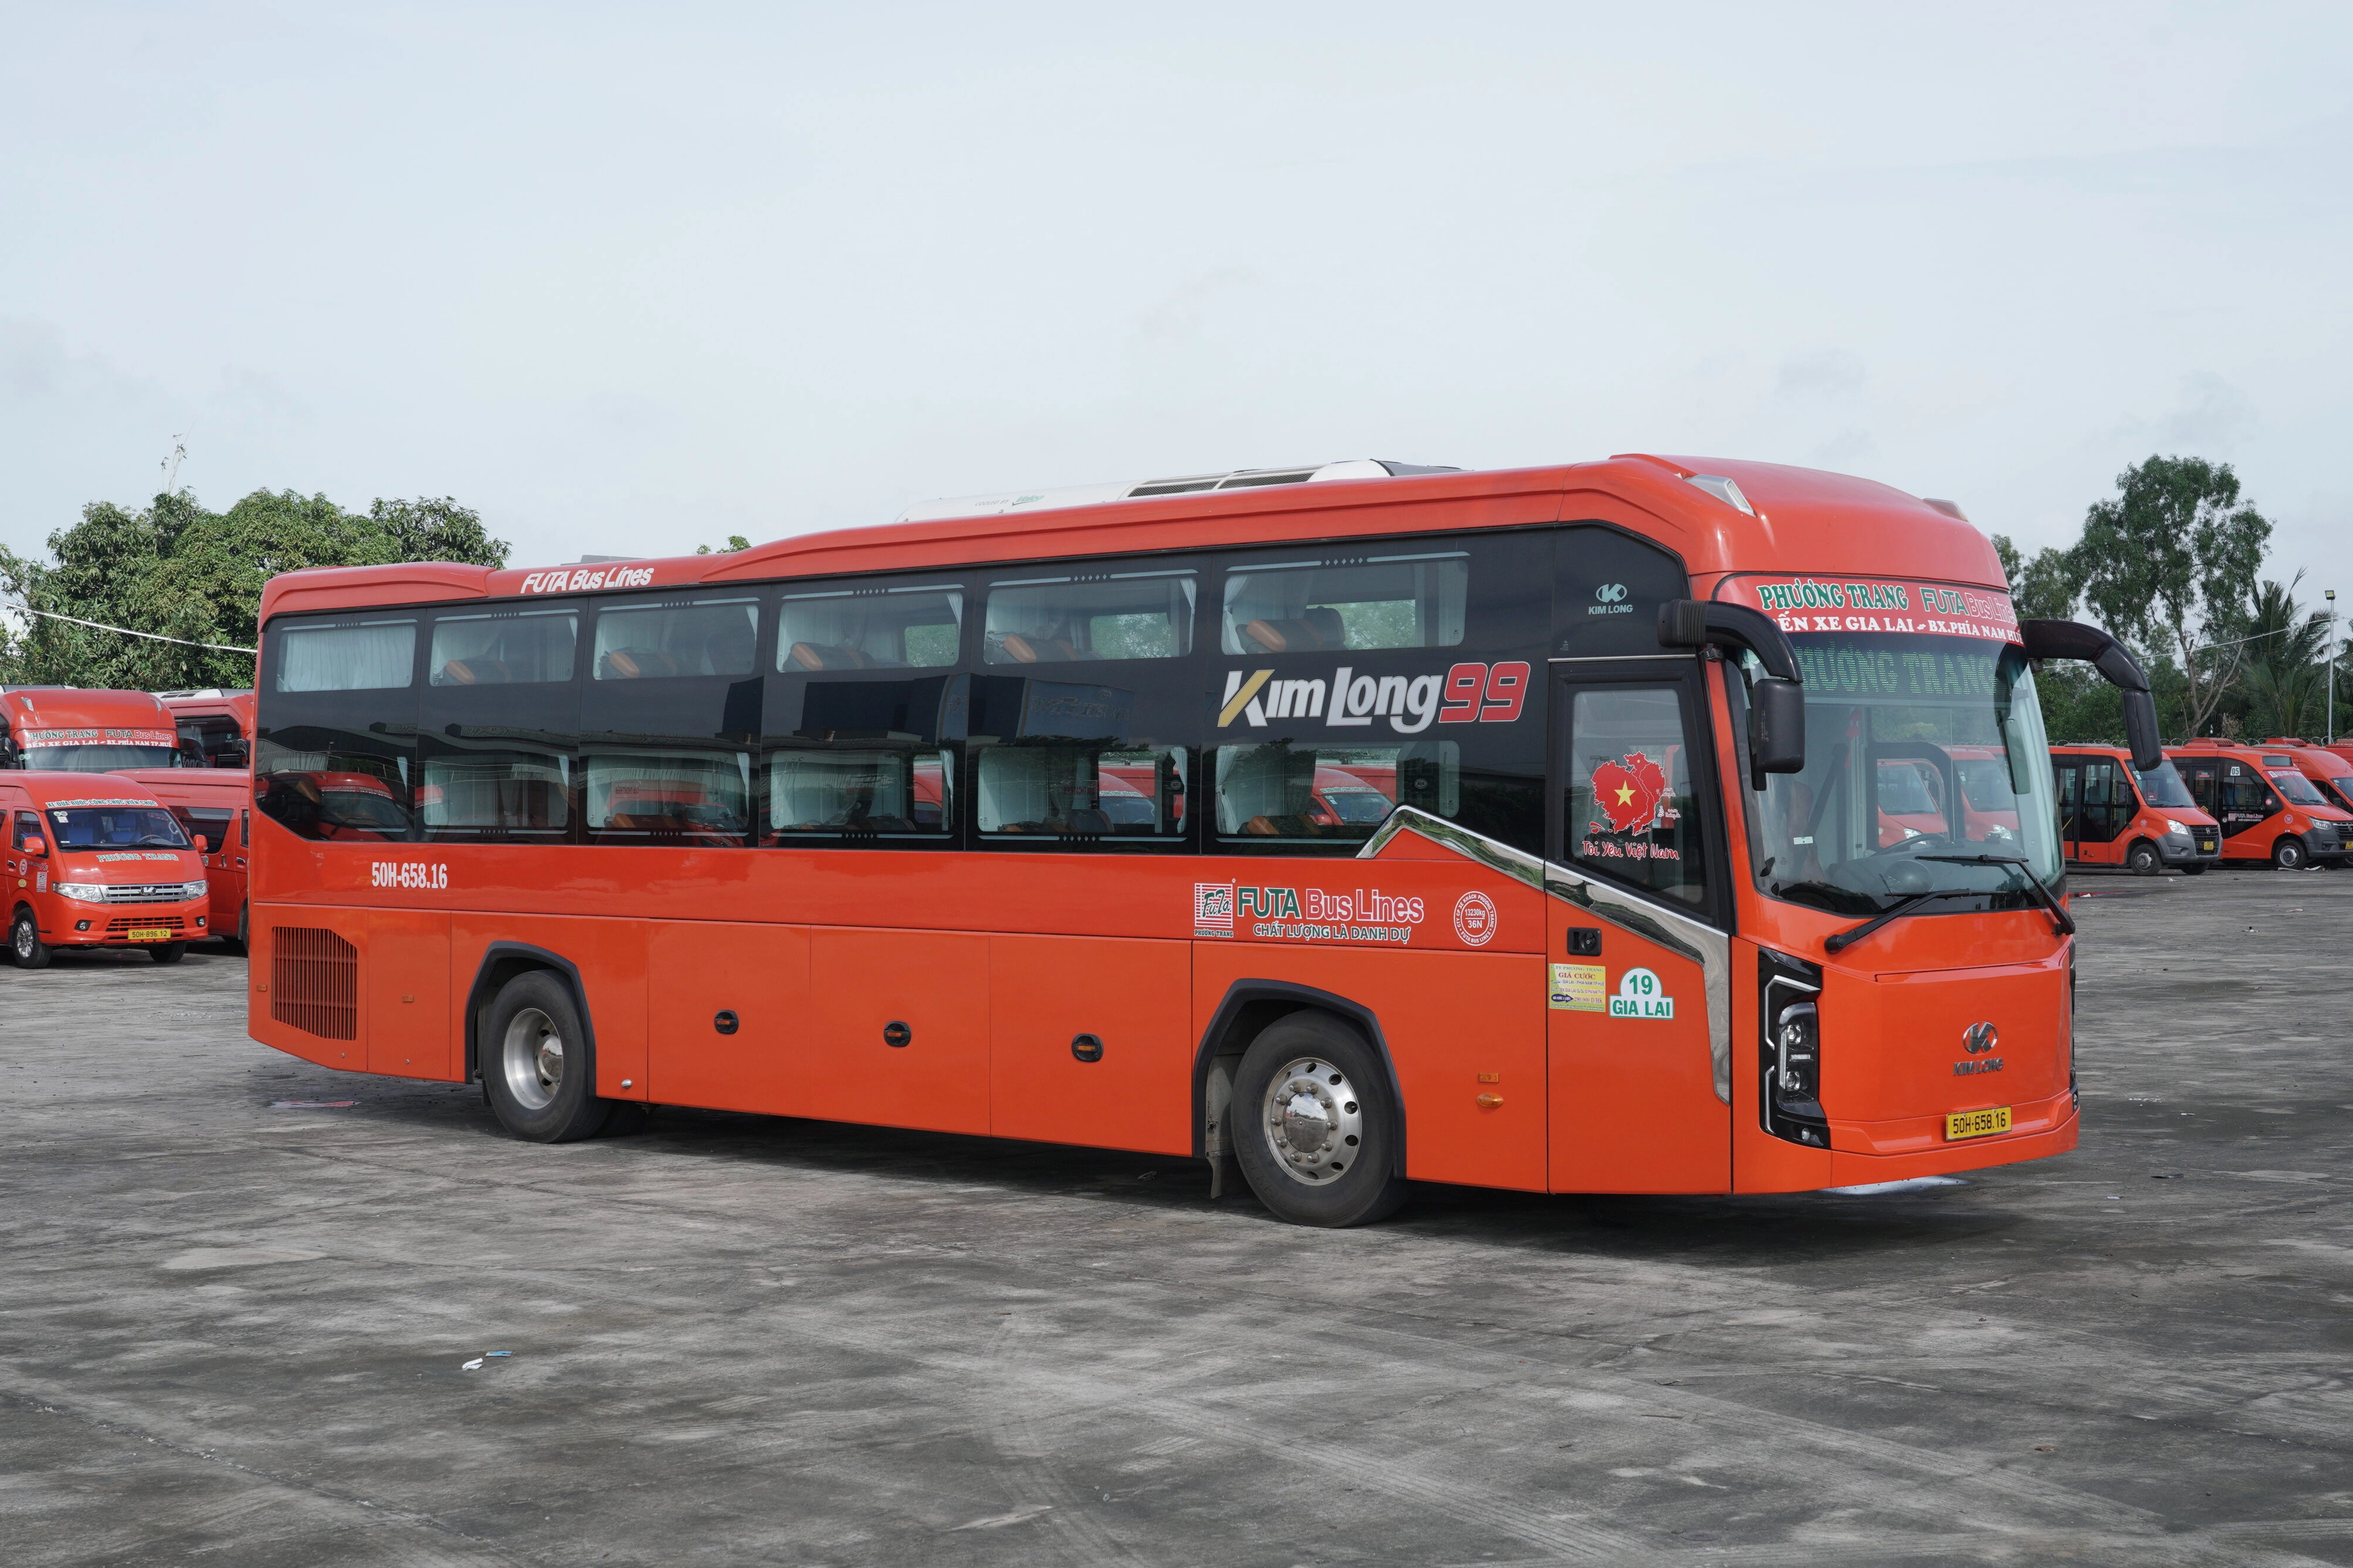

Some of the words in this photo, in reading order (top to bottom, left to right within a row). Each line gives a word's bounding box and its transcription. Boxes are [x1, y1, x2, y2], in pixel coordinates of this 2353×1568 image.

[521, 571, 571, 594] FUTA
[569, 569, 605, 590] Bus
[604, 566, 654, 588] Lines
[1757, 578, 1845, 610] PHƯƠNG
[1845, 584, 1909, 610] TRANG
[1919, 587, 1970, 616] FUTA
[1964, 592, 1993, 620] Bus
[1589, 605, 1606, 615] KIM
[1608, 604, 1633, 614] LONG
[1772, 611, 1809, 631] ẾN
[1813, 616, 1842, 631] XE
[1845, 616, 1881, 631] GIA
[1883, 616, 1915, 632] LAI
[1927, 619, 1980, 637] BX.PHÍA
[1981, 625, 2007, 640] NAM
[1794, 639, 1899, 693] HƯƠNG
[1901, 651, 1999, 695] TRANG
[26, 730, 64, 741] PHƯƠNG
[67, 730, 98, 738] TRANG
[106, 730, 134, 738] FUTA
[134, 730, 150, 739] Bus
[151, 731, 173, 740] Lines
[97, 853, 141, 862] PHƯƠNG
[142, 853, 178, 861] TRANG
[1582, 841, 1600, 856] Tôi
[1602, 841, 1623, 857] Yêu
[1625, 842, 1648, 860] Việt
[1651, 843, 1680, 860] Nam
[372, 862, 448, 889] 50H-658.16
[1237, 886, 1300, 920] FUTA
[1305, 889, 1353, 921] Bus
[1356, 889, 1424, 924] Lines
[1463, 894, 1477, 903] KHÁCH
[1465, 909, 1485, 917] 13230kg
[1194, 929, 1215, 937] PHƯƠNG
[1253, 921, 1284, 937] CHẤT
[1287, 924, 1330, 941] LƯỢNG
[1333, 924, 1349, 939] LÀ
[1351, 926, 1388, 941] DANH
[1390, 926, 1411, 944] DỰ
[1468, 920, 1483, 929] 36N
[1461, 931, 1470, 942] FUTA
[1480, 931, 1491, 942] LINES
[1629, 974, 1653, 995] 19
[1612, 999, 1639, 1015] GIA
[1645, 1000, 1670, 1016] LAI
[1953, 1060, 1974, 1076] KIM
[1976, 1058, 2004, 1073] LONG
[1953, 1112, 2006, 1134] 50H-658.16
